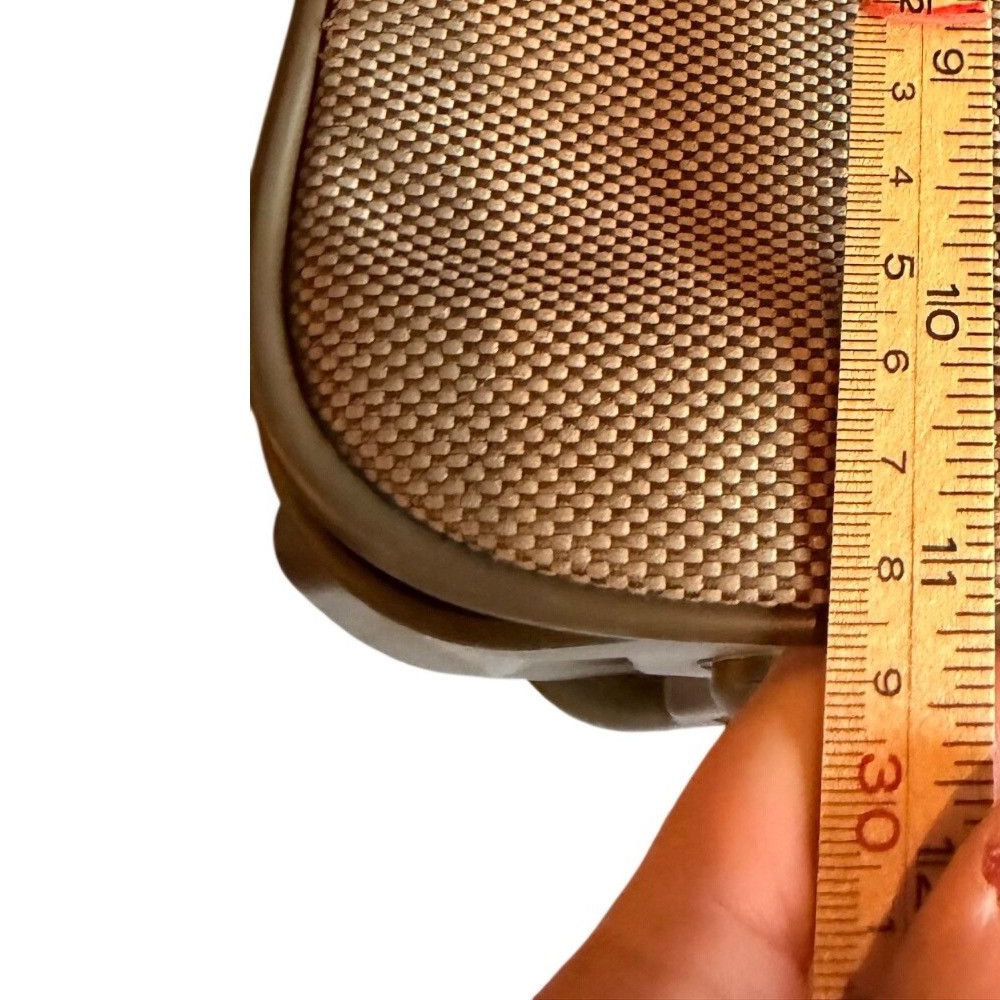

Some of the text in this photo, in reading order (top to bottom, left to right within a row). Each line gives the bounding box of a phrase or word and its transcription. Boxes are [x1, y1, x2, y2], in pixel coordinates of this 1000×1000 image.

[932, 48, 964, 75] 9
[891, 81, 916, 101] 3
[889, 166, 913, 187] 4
[884, 253, 914, 280] 5
[925, 284, 960, 341] 10
[883, 349, 909, 373] 6
[881, 450, 907, 474] 7
[877, 556, 904, 582] 8
[920, 537, 957, 585] 11
[872, 668, 902, 697] 9
[855, 753, 902, 852] 30
